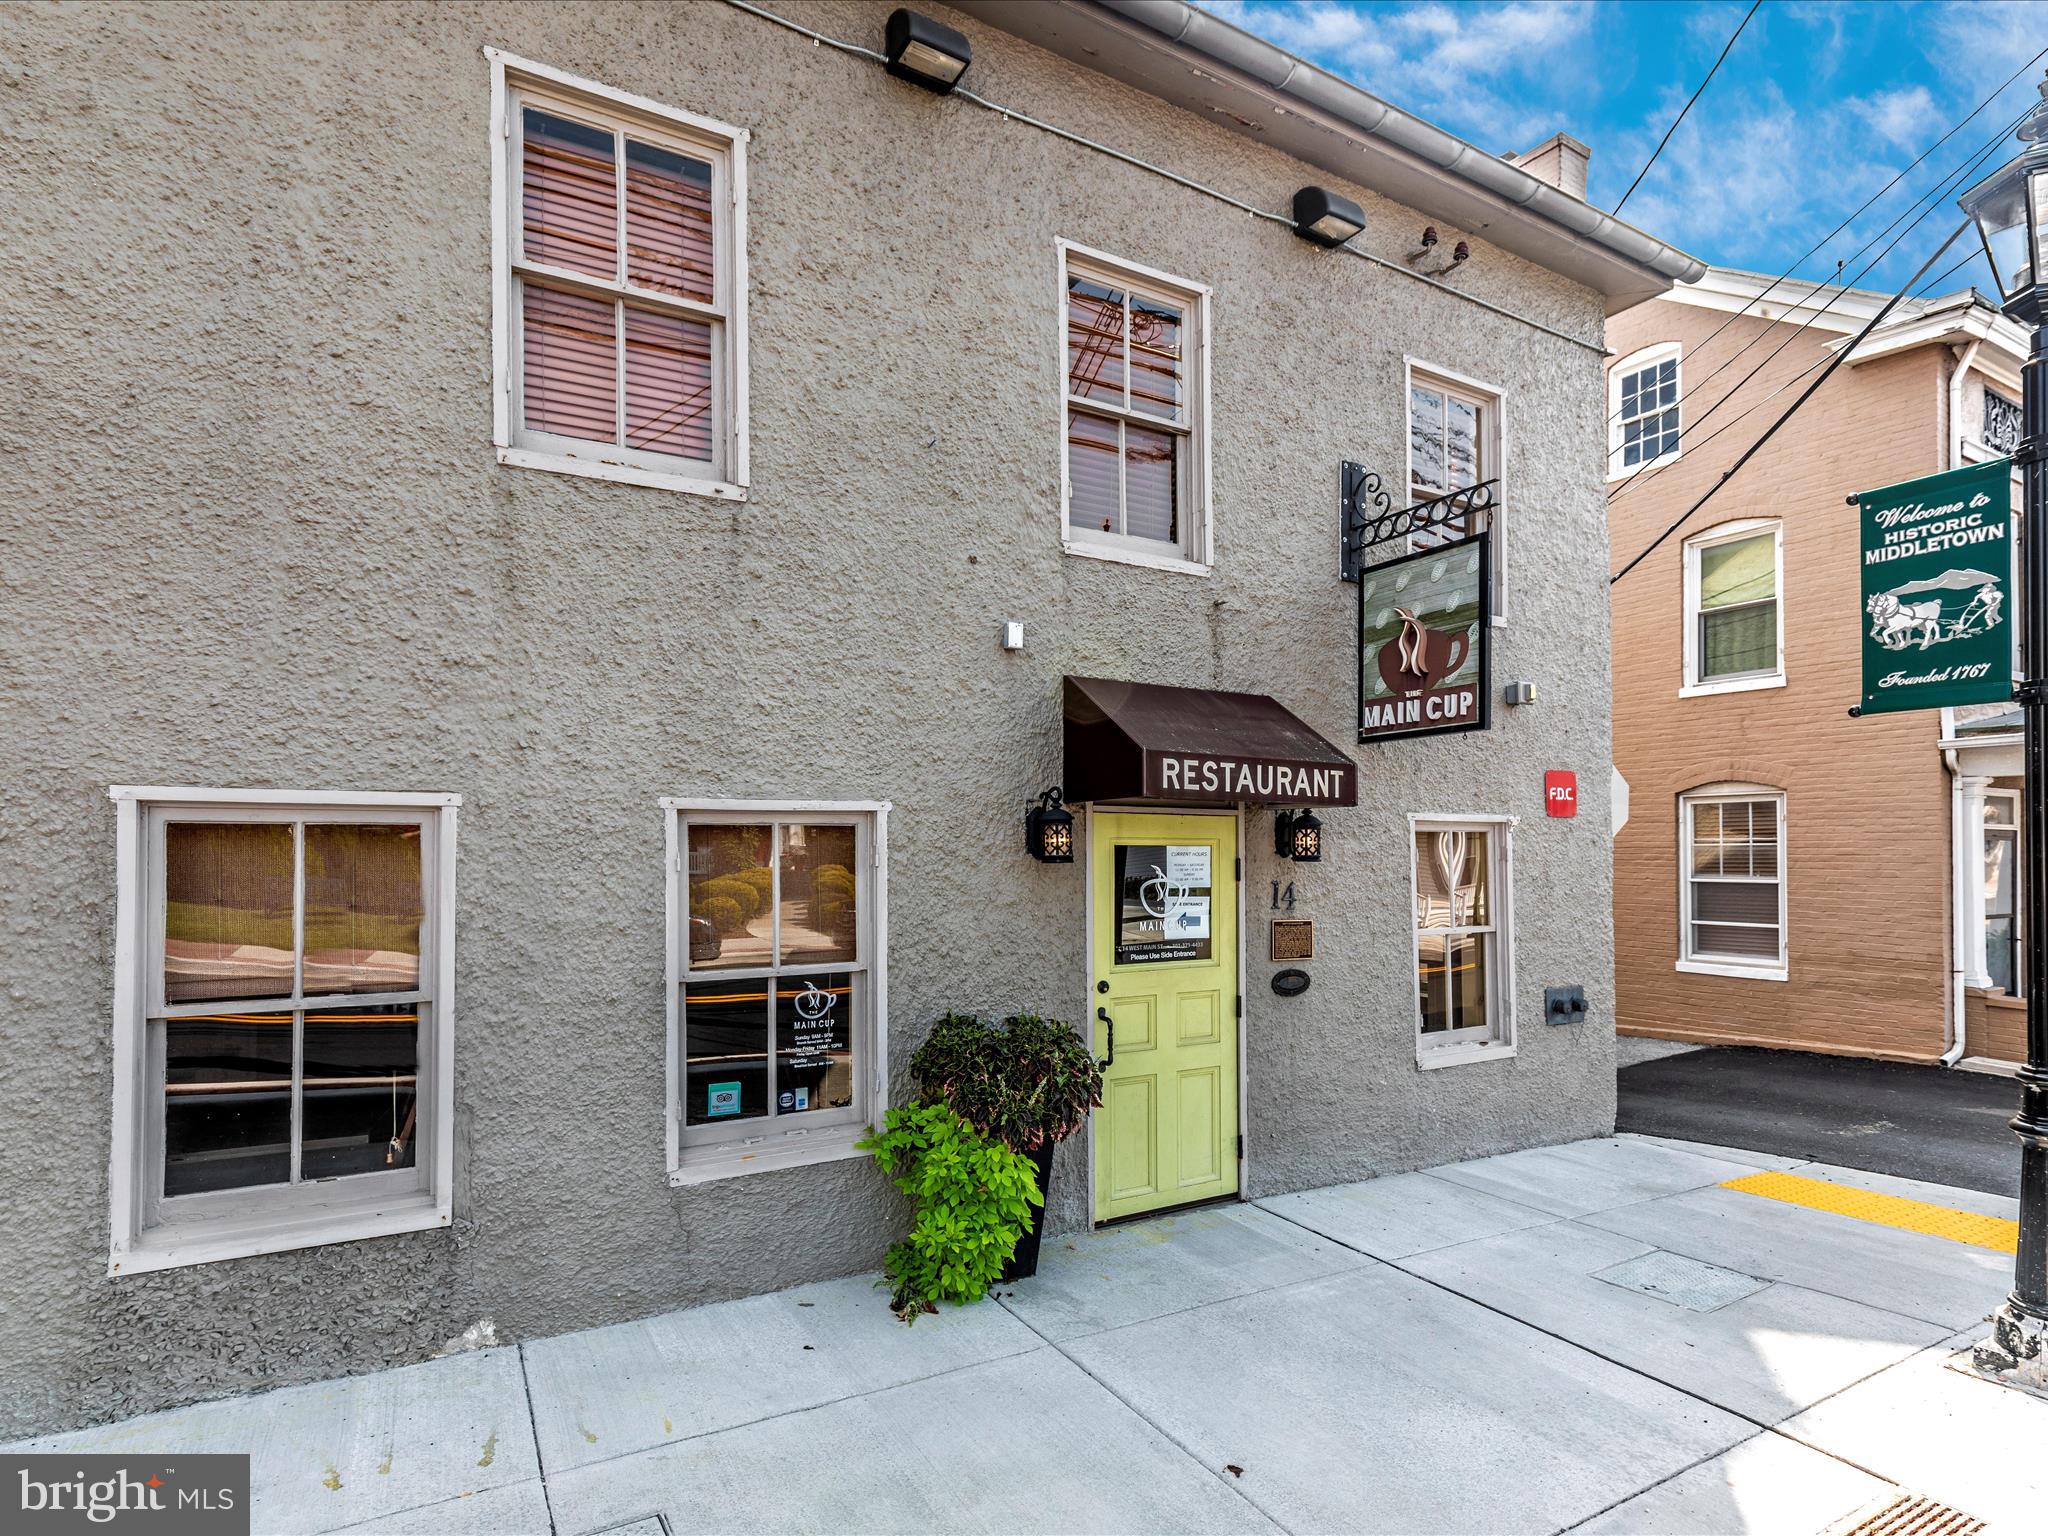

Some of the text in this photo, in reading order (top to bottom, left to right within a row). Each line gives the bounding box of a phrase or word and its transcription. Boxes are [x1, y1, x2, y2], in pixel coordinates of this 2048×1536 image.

[1874, 492, 1992, 529] Welcome to
[1865, 522, 2005, 565] MIDDLETOWN
[1884, 513, 1983, 545] HISTORIC
[1878, 662, 1992, 688] Founded 1767
[1364, 691, 1473, 728] MAIN CUP
[1162, 757, 1344, 799] RESTAURANT
[1270, 880, 1297, 910] 14
[793, 1019, 835, 1030] MAIN CUP
